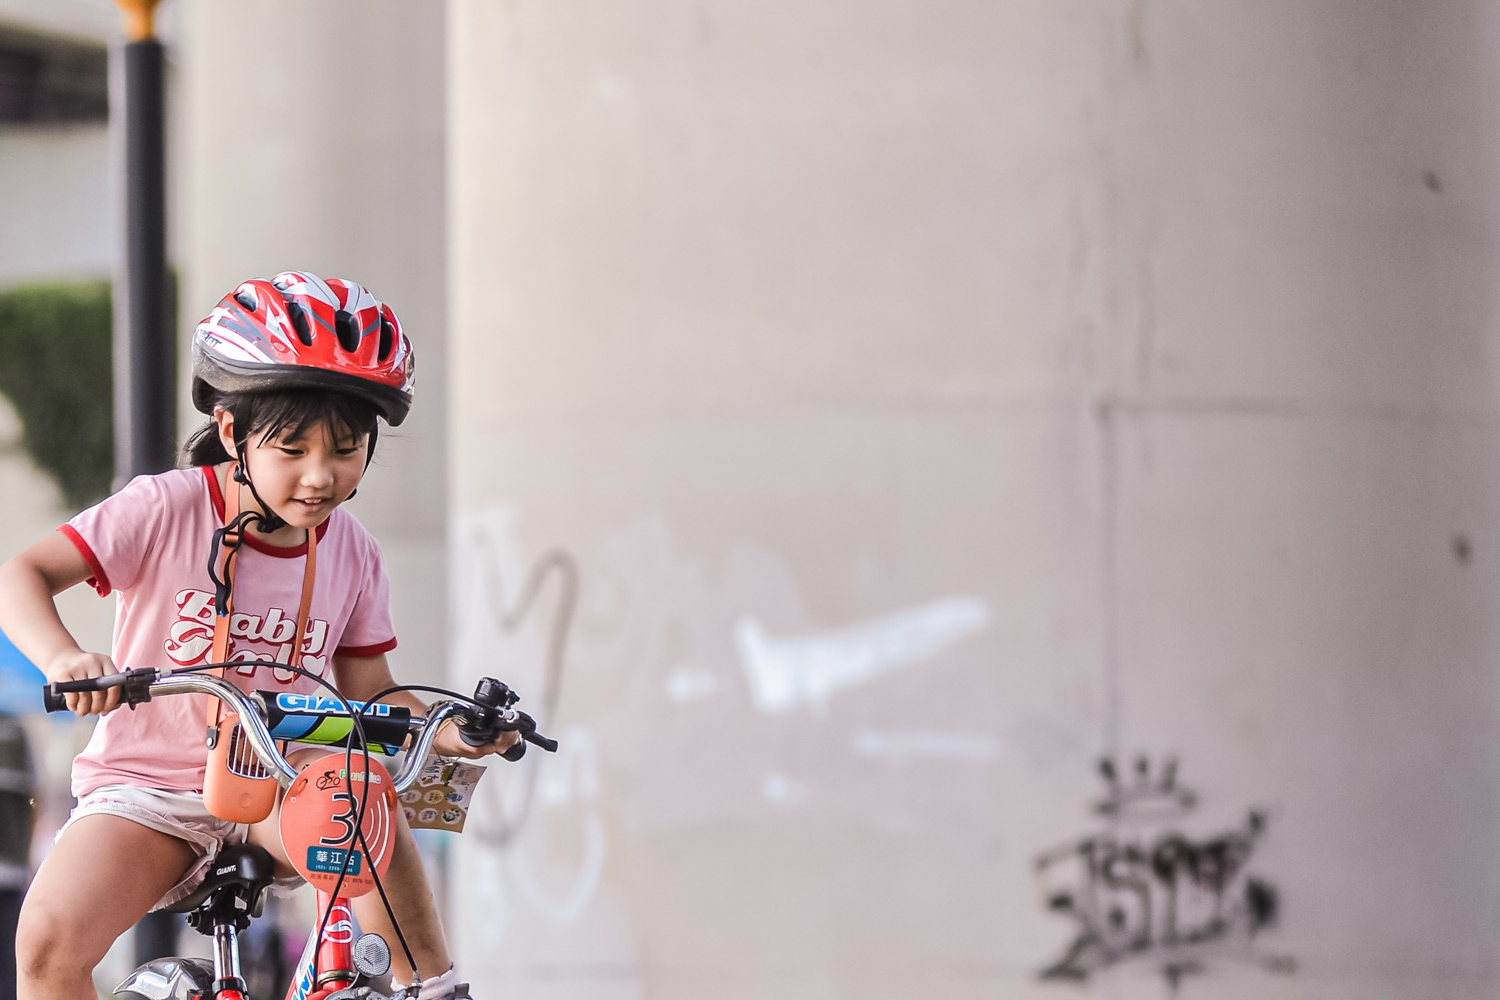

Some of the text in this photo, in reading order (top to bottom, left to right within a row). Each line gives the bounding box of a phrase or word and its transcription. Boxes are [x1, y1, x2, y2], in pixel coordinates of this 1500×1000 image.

[175, 589, 329, 656] Baby
[276, 693, 390, 716] GIANT
[319, 792, 359, 847] 3
[216, 864, 237, 876] GIANT
